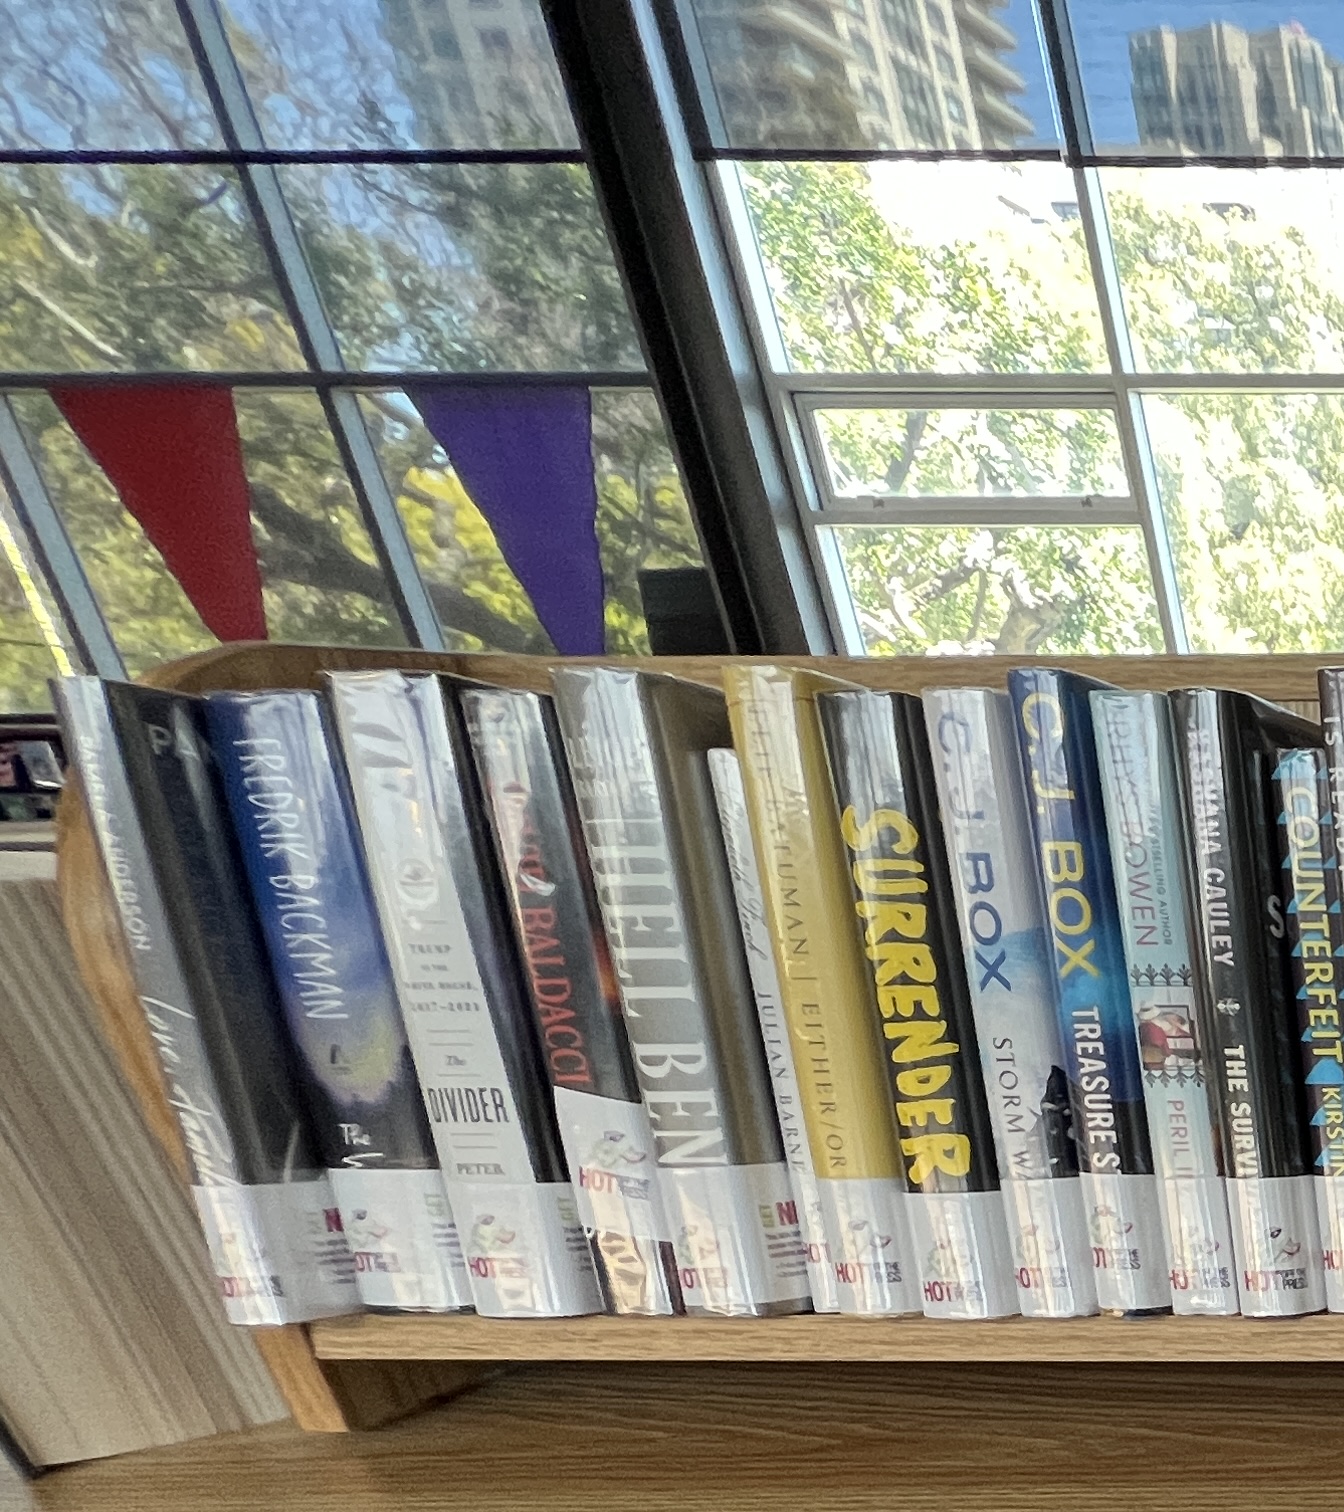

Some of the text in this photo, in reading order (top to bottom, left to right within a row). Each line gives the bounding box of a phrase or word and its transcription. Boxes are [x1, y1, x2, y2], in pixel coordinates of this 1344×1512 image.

[232, 738, 348, 1020] FREDRIK BACKMAN
[964, 853, 1010, 992] BOX
[1042, 841, 1099, 979] BOX
[1202, 868, 1234, 966] CAULEY
[1283, 785, 1344, 1063] COUNTERFEIT
[521, 908, 591, 1084] BALDACCI
[841, 805, 971, 1185] SURRENDER
[428, 1088, 508, 1122] DIVIDER
[801, 1002, 846, 1170] EITHER/OR
[992, 1038, 1026, 1133] STORM
[1072, 1008, 1115, 1143] TREASURE
[1224, 1046, 1250, 1092] THE
